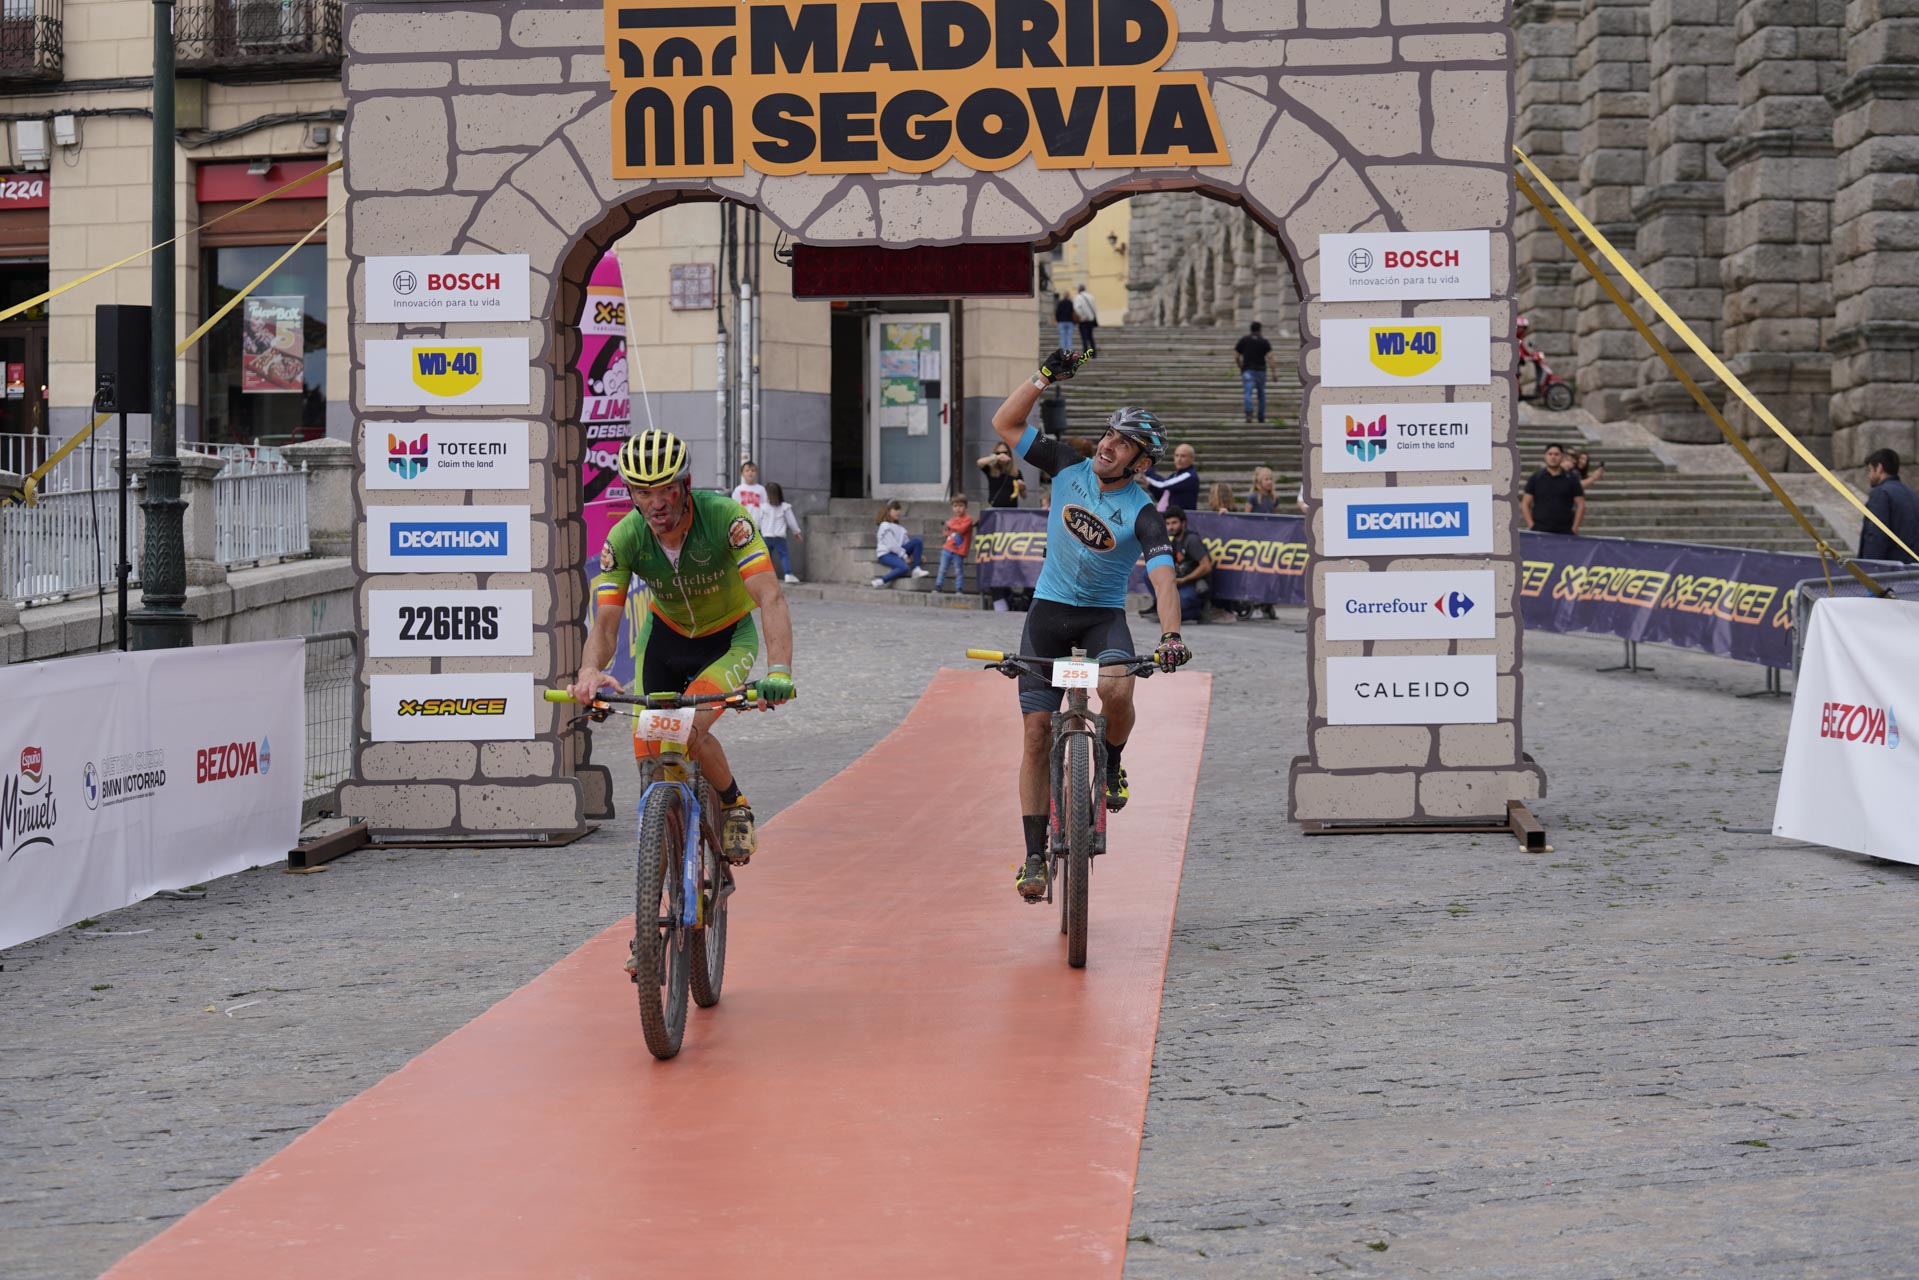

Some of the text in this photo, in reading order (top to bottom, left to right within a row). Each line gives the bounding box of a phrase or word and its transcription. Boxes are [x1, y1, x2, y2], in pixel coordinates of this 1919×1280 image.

[750, 0, 1168, 75] MADRID
[752, 84, 1218, 164] SEGOVIA
[1384, 249, 1459, 268] BOSCH
[428, 273, 500, 291] BOSCH
[1349, 275, 1460, 287] Innovación para tu vida
[394, 298, 501, 309] Innovación para tu vida
[1375, 331, 1437, 356] WD-40
[418, 352, 477, 376] WD-40
[1397, 423, 1469, 437] TOTEEMI
[438, 443, 507, 455] TOTEEMI
[1397, 441, 1455, 450] Claim the land
[438, 460, 494, 468] Claim the land
[1356, 511, 1460, 531] DECATHLON
[399, 531, 499, 548] DECATHLON
[1070, 518, 1103, 546] JAVI
[673, 569, 726, 587] Ciclista
[1345, 598, 1428, 614] Carrefour
[399, 606, 499, 640] 226ERS
[1062, 669, 1089, 679] 255
[1354, 681, 1470, 698] CALEIDO
[397, 698, 508, 716] X-SAUCE
[650, 714, 681, 732] 303
[1821, 702, 1886, 746] BEZOYA
[197, 741, 258, 784] BEZOYA
[102, 778, 122, 799] BMW
[123, 769, 166, 793] MOTORRAD
[0, 773, 57, 851] Minuets
